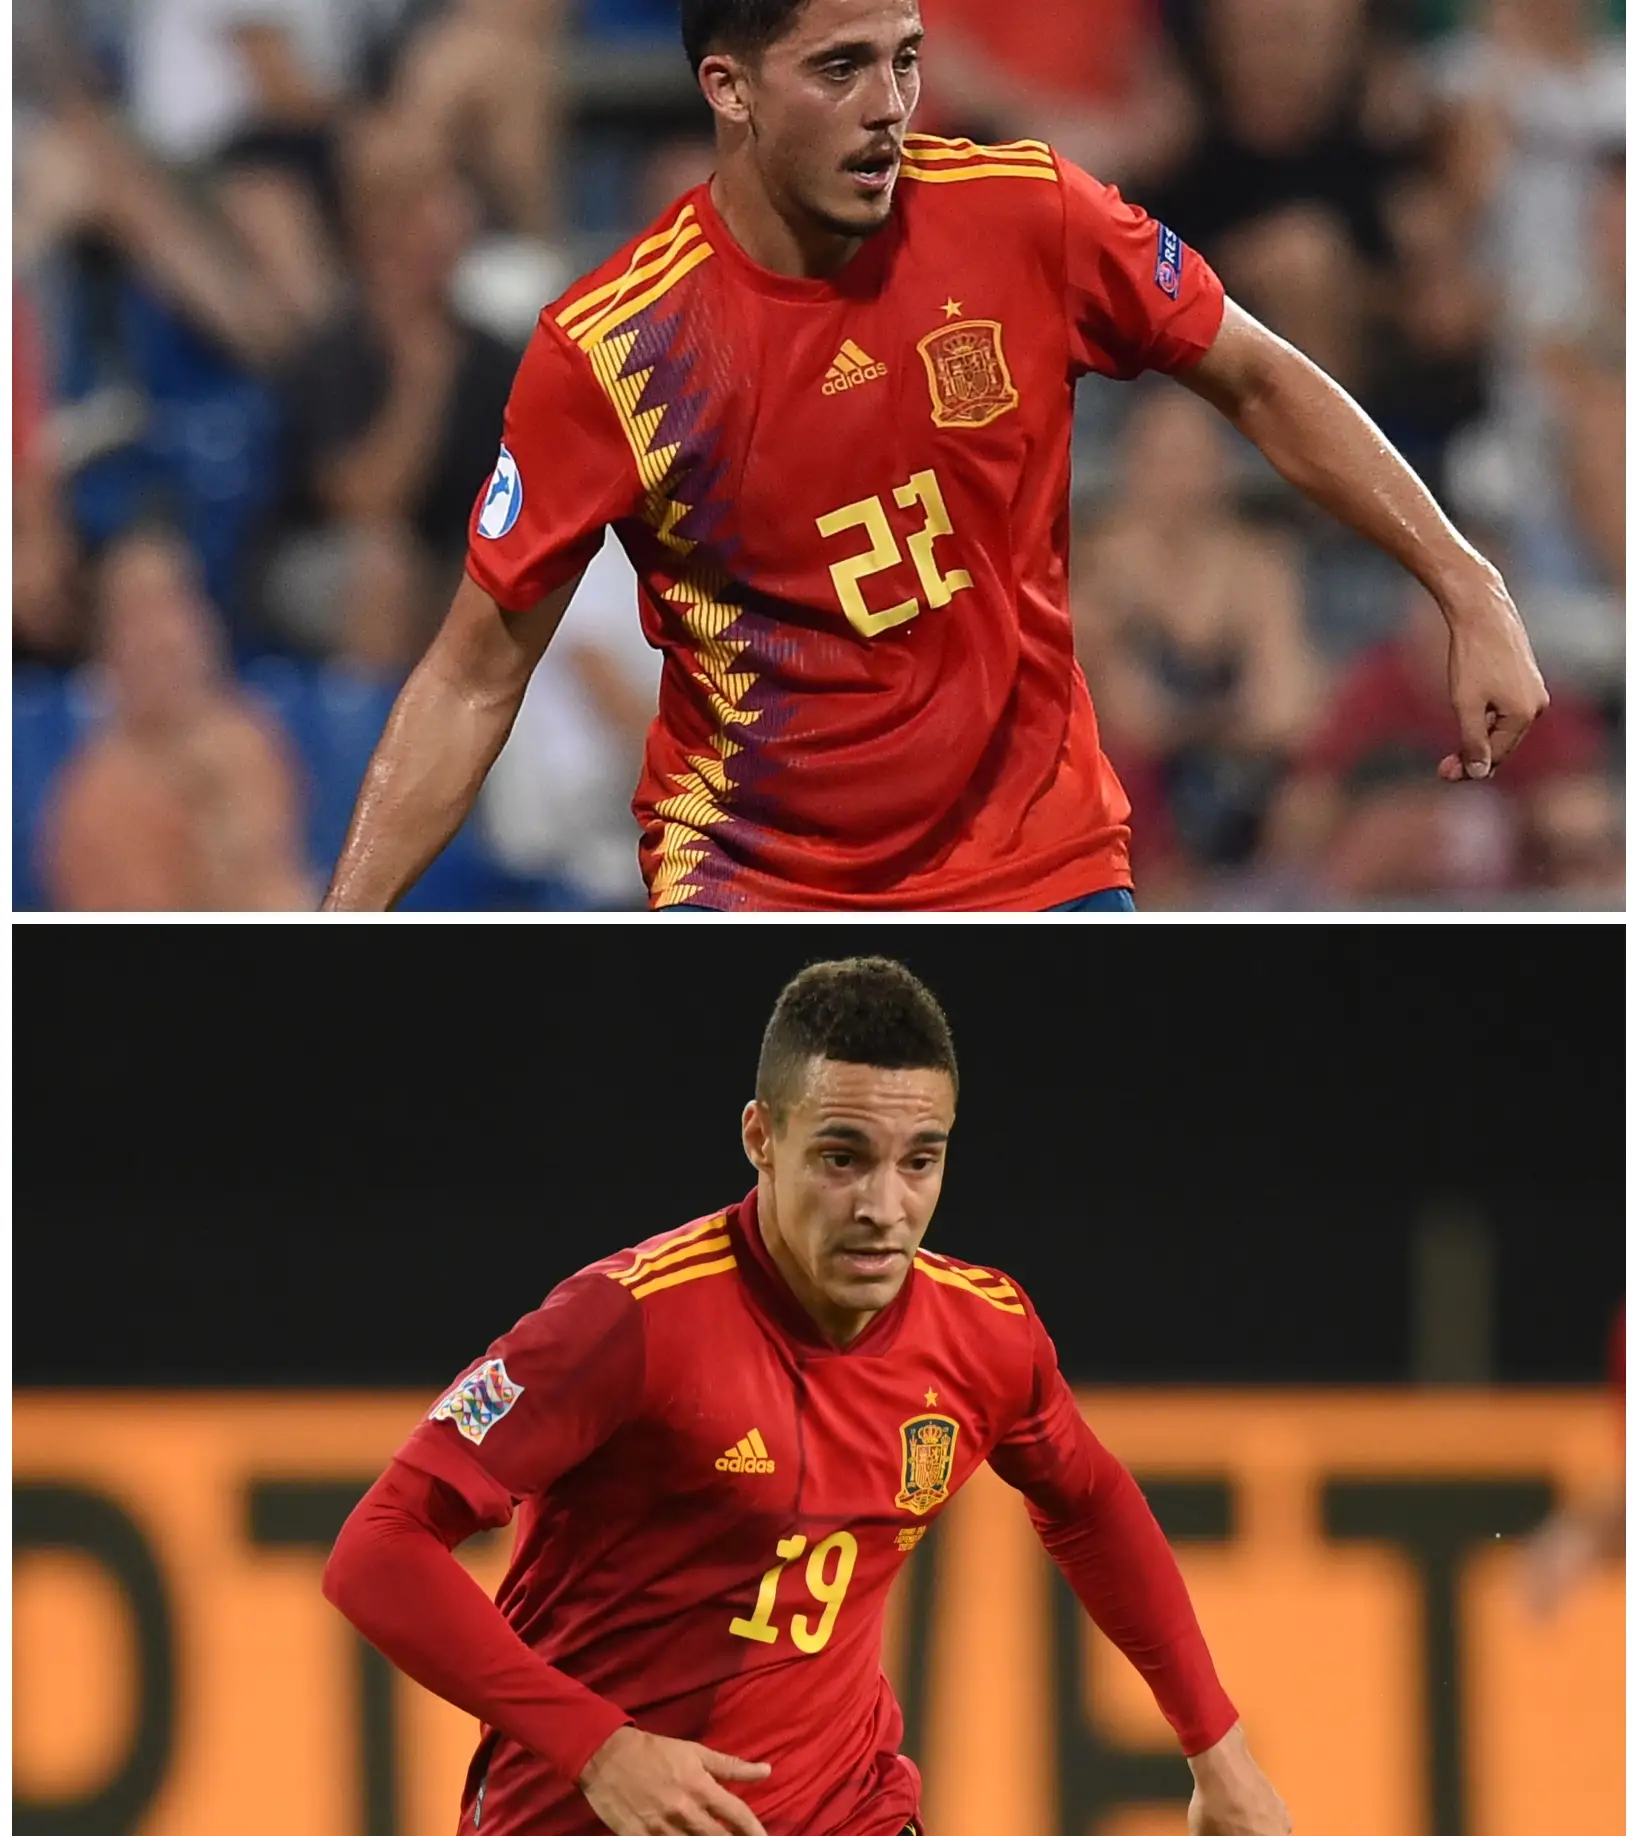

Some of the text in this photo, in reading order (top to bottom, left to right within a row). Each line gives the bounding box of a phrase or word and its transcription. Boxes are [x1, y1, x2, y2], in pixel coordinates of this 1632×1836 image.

[821, 362, 888, 396] adidas
[815, 468, 974, 638] 22
[714, 1456, 775, 1474] adidas
[728, 1530, 858, 1654] 19
